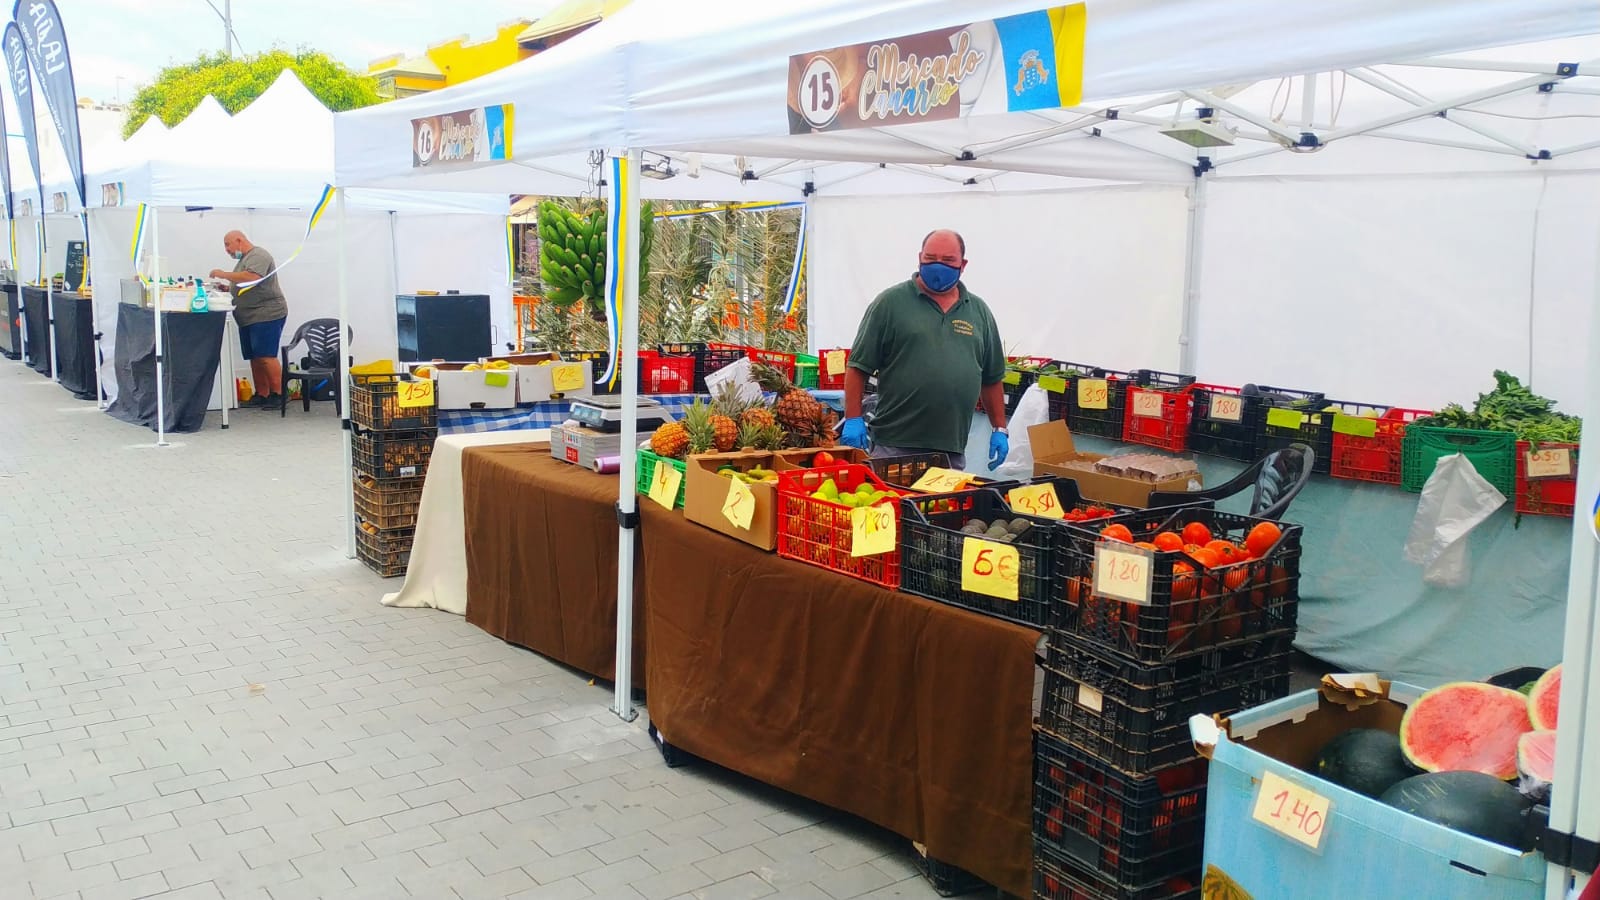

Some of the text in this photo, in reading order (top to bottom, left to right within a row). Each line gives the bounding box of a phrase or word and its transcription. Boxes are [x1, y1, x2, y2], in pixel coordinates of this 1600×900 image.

[867, 31, 984, 91] Mercado
[808, 71, 833, 112] 15
[859, 69, 959, 120] Canario
[421, 130, 431, 153] 16
[1108, 557, 1140, 584] 1.20
[1270, 790, 1323, 836] 1.40
